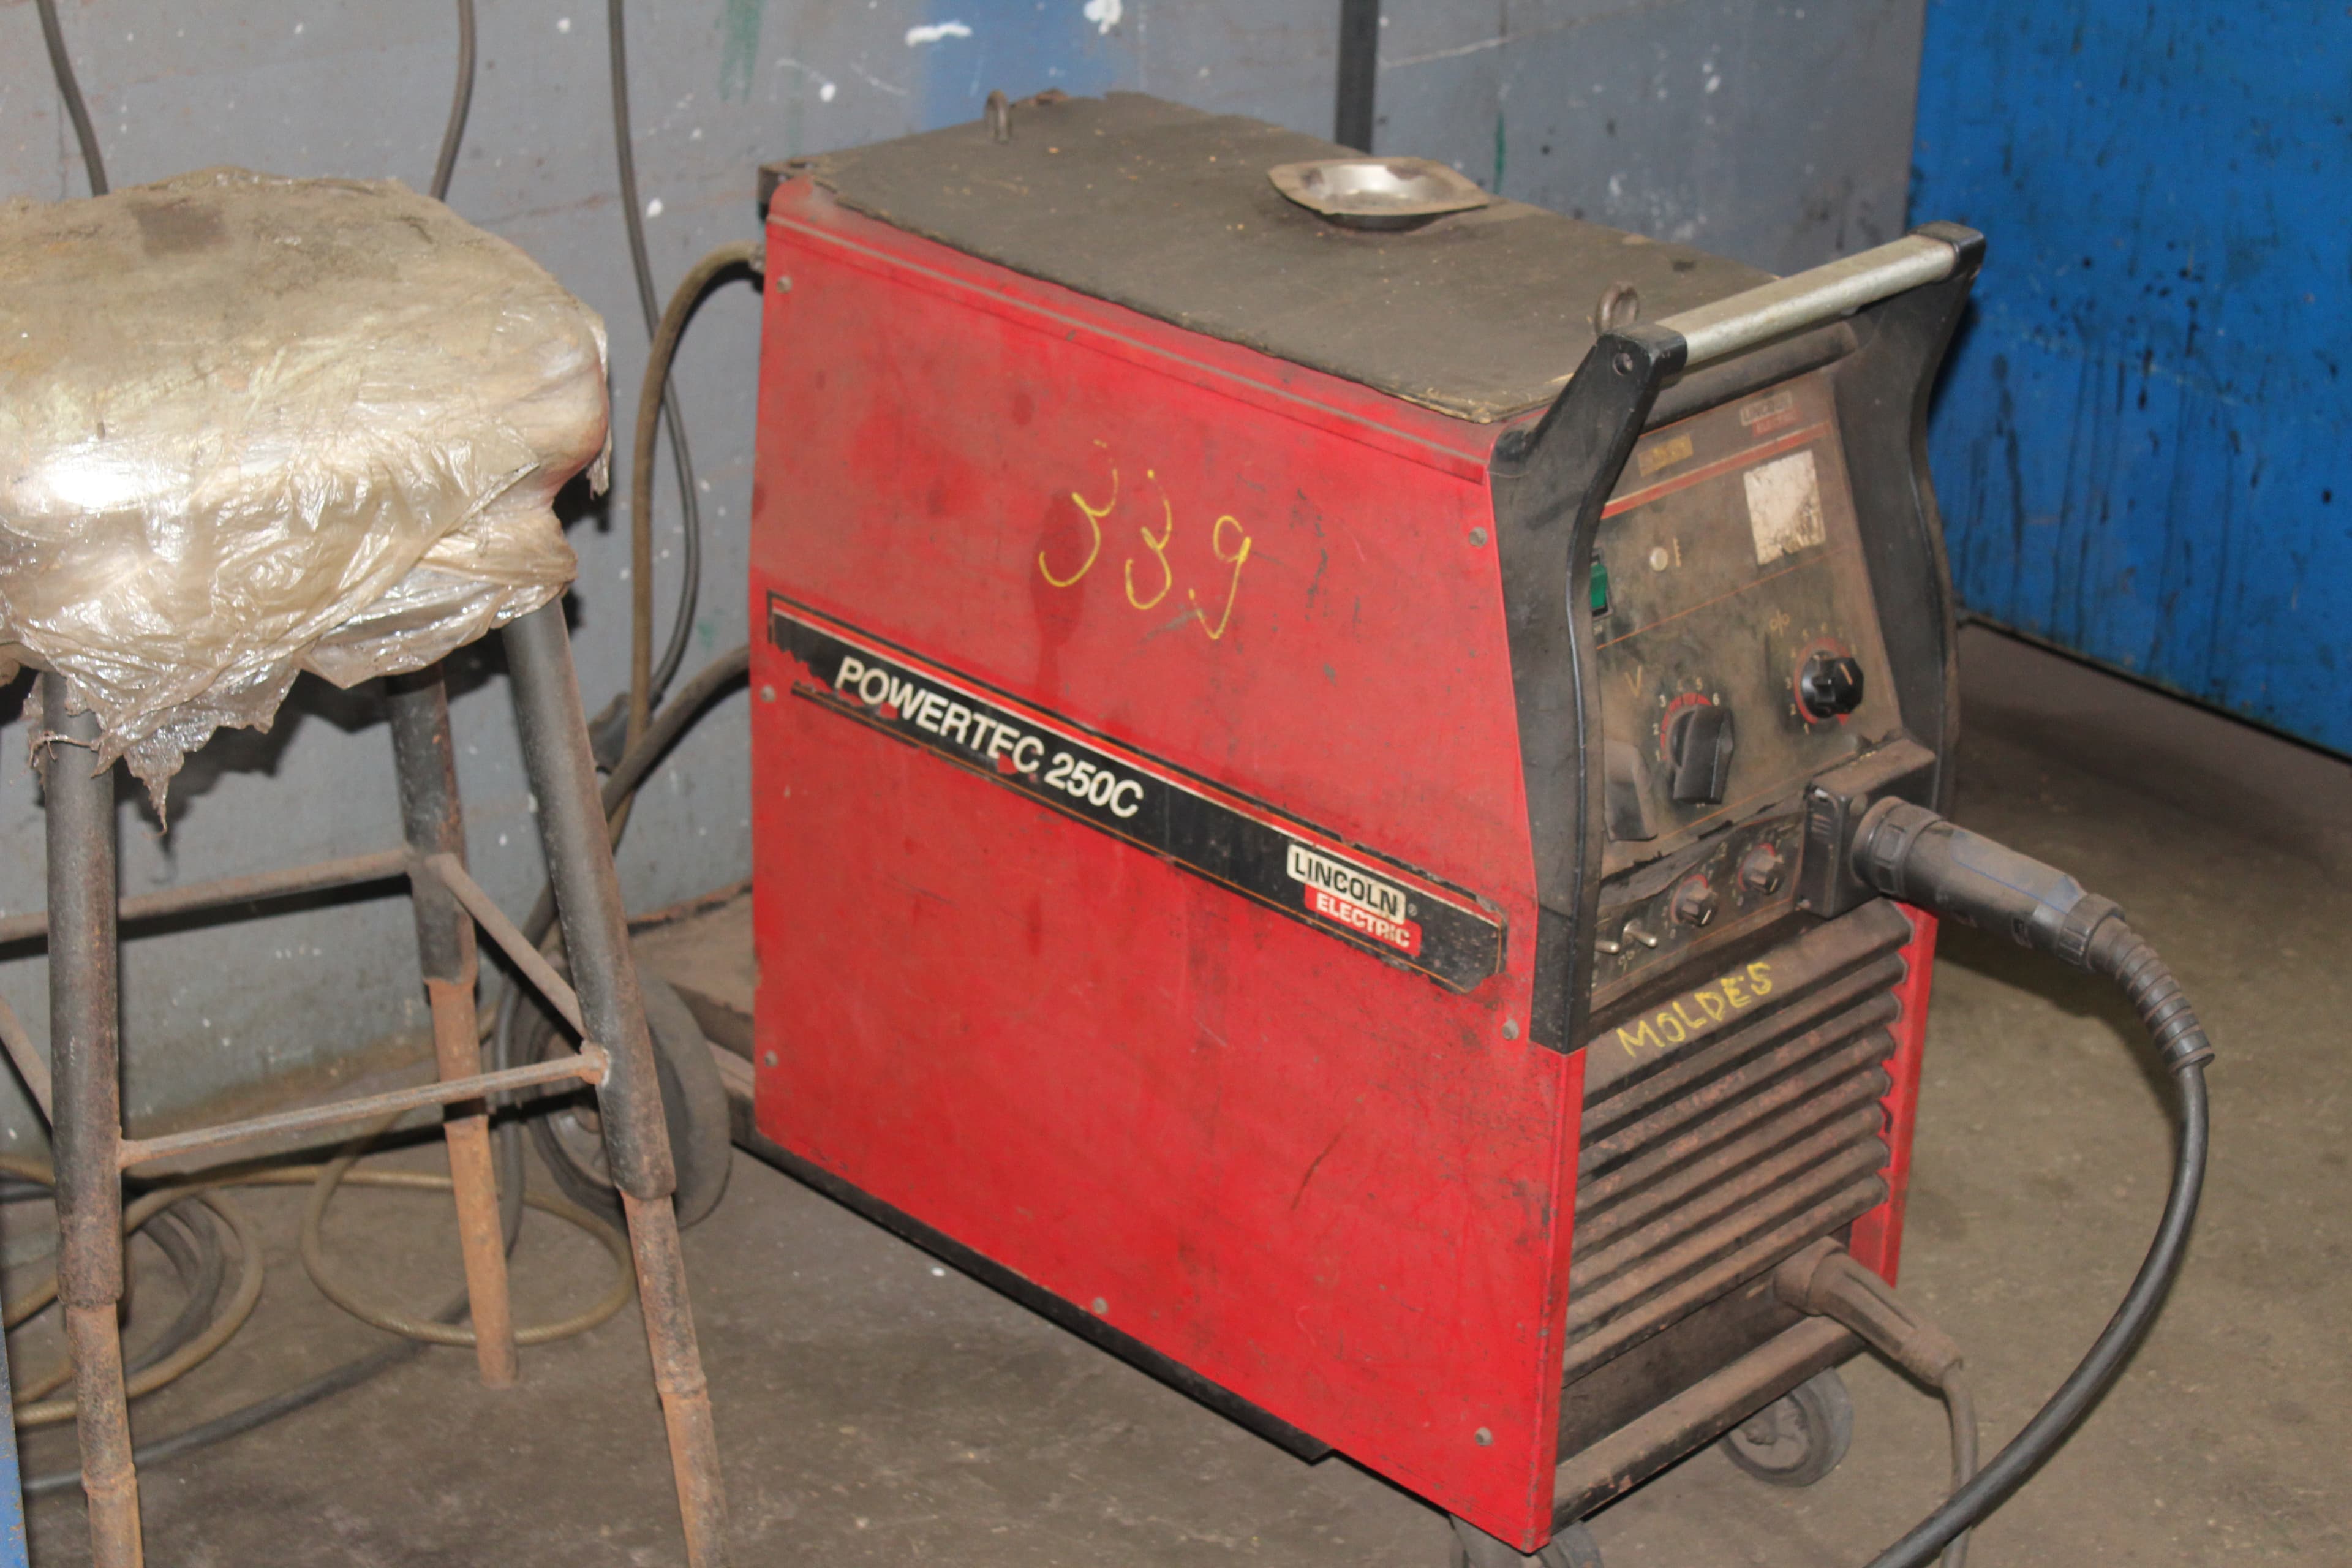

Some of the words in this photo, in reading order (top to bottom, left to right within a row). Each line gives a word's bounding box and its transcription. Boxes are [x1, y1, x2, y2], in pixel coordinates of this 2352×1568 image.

[834, 655, 1044, 773] POWERTEC
[1044, 752, 1144, 818] 250C
[1294, 852, 1401, 917] LINCOLN
[1316, 892, 1411, 949] ELECTRIC
[1616, 961, 1773, 1058] MOLDES
